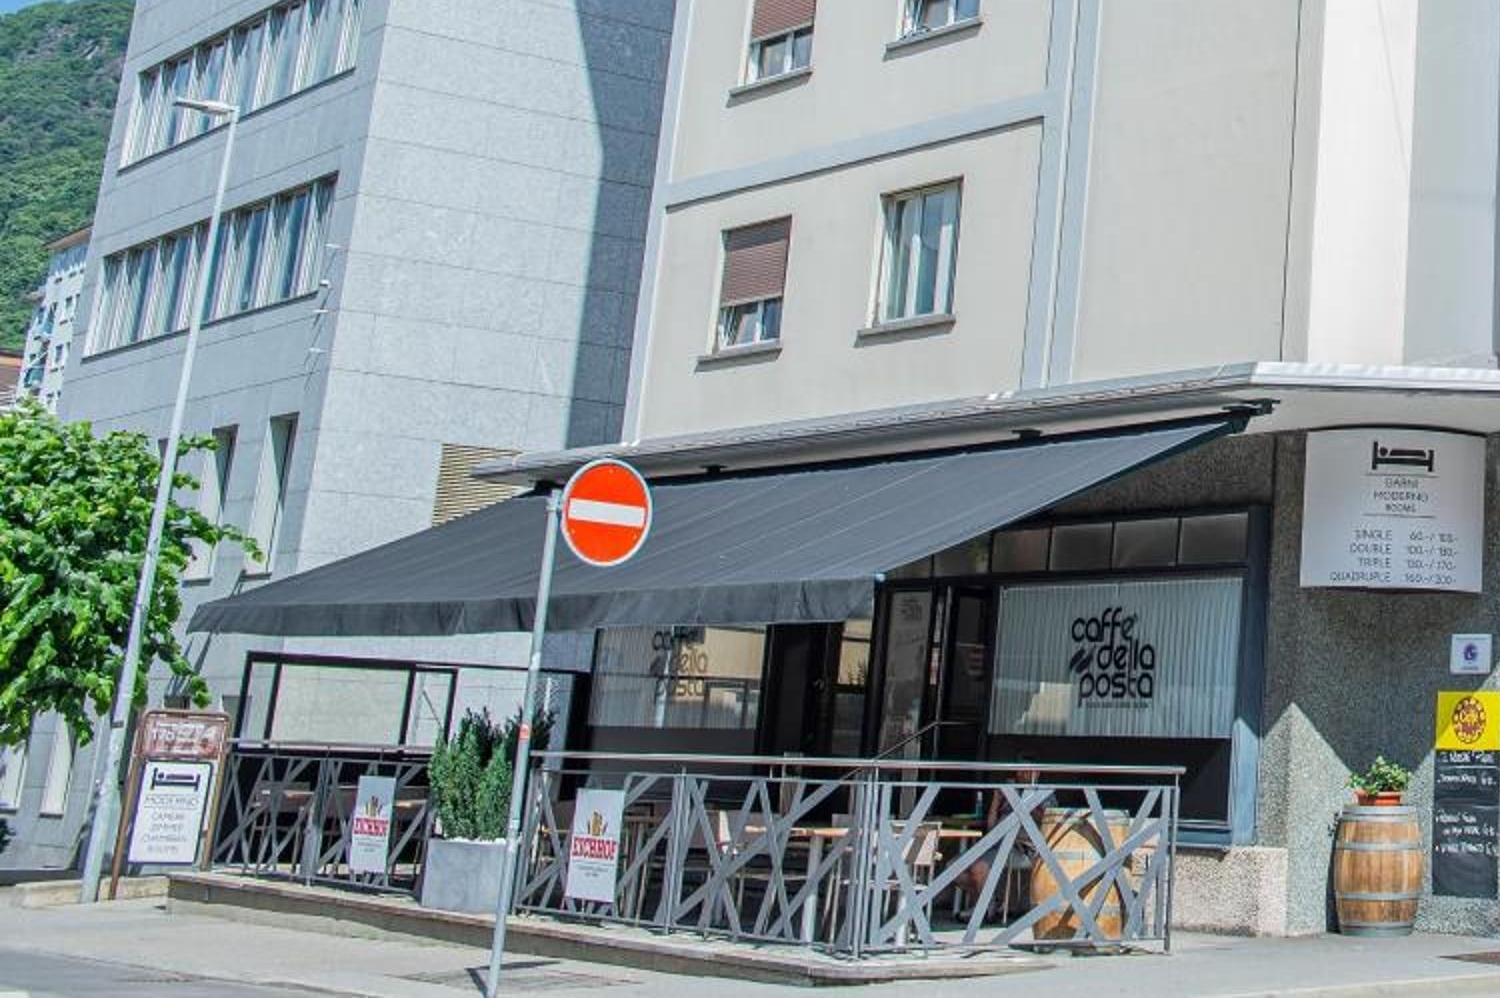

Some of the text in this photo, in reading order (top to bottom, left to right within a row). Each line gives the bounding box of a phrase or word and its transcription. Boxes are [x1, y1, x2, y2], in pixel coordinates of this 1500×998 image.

[1384, 477, 1419, 489] GARNI
[1373, 490, 1429, 502] MODERNO
[1385, 503, 1417, 513] ROOMS
[1354, 529, 1392, 541] SINGLE
[1350, 543, 1392, 555] DOUBLE
[1358, 557, 1392, 569] TRIPLE
[1329, 571, 1391, 583] QUADRUPLE
[1097, 637, 1155, 670] della
[1079, 672, 1153, 708] posta
